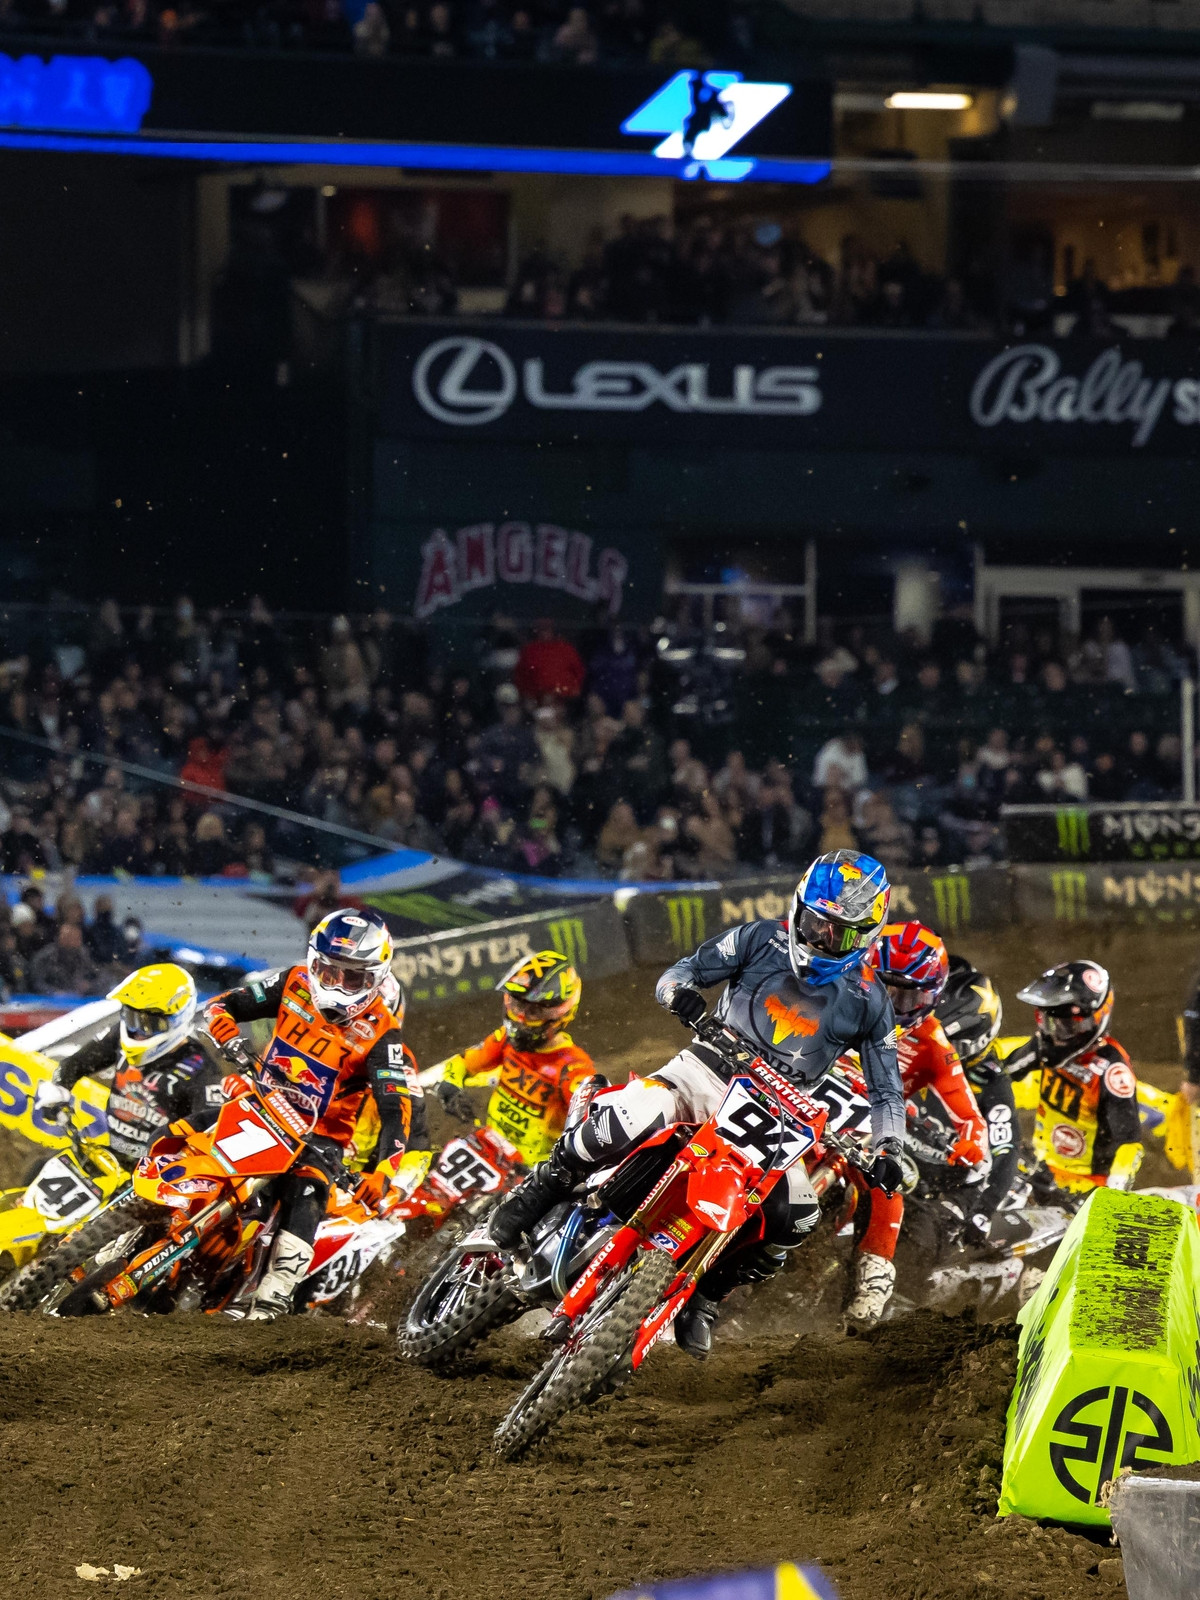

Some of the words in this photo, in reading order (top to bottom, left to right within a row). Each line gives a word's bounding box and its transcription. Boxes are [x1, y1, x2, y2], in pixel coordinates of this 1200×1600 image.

[523, 357, 823, 416] LEXUS
[969, 344, 1171, 447] Bally
[415, 521, 628, 618] ANGELS
[1103, 870, 1200, 908] MON
[390, 933, 538, 988] ONSTER
[755, 1050, 807, 1083] ONDA
[273, 1091, 309, 1131] RENTHAL
[754, 1065, 818, 1119] RENTHAL
[765, 1095, 794, 1123] MOSTER
[811, 1078, 871, 1134] 51
[1040, 1070, 1077, 1112] FLY
[107, 1115, 150, 1142] SUZU
[267, 1096, 305, 1136] RENTHAL
[715, 1101, 798, 1171] 94
[216, 1118, 279, 1163] 1
[436, 1147, 495, 1193] 95
[37, 1175, 91, 1218] 41
[143, 1231, 193, 1273] DUNLP
[569, 1240, 615, 1298] DUNLOP
[642, 1297, 686, 1358] DUNLOP
